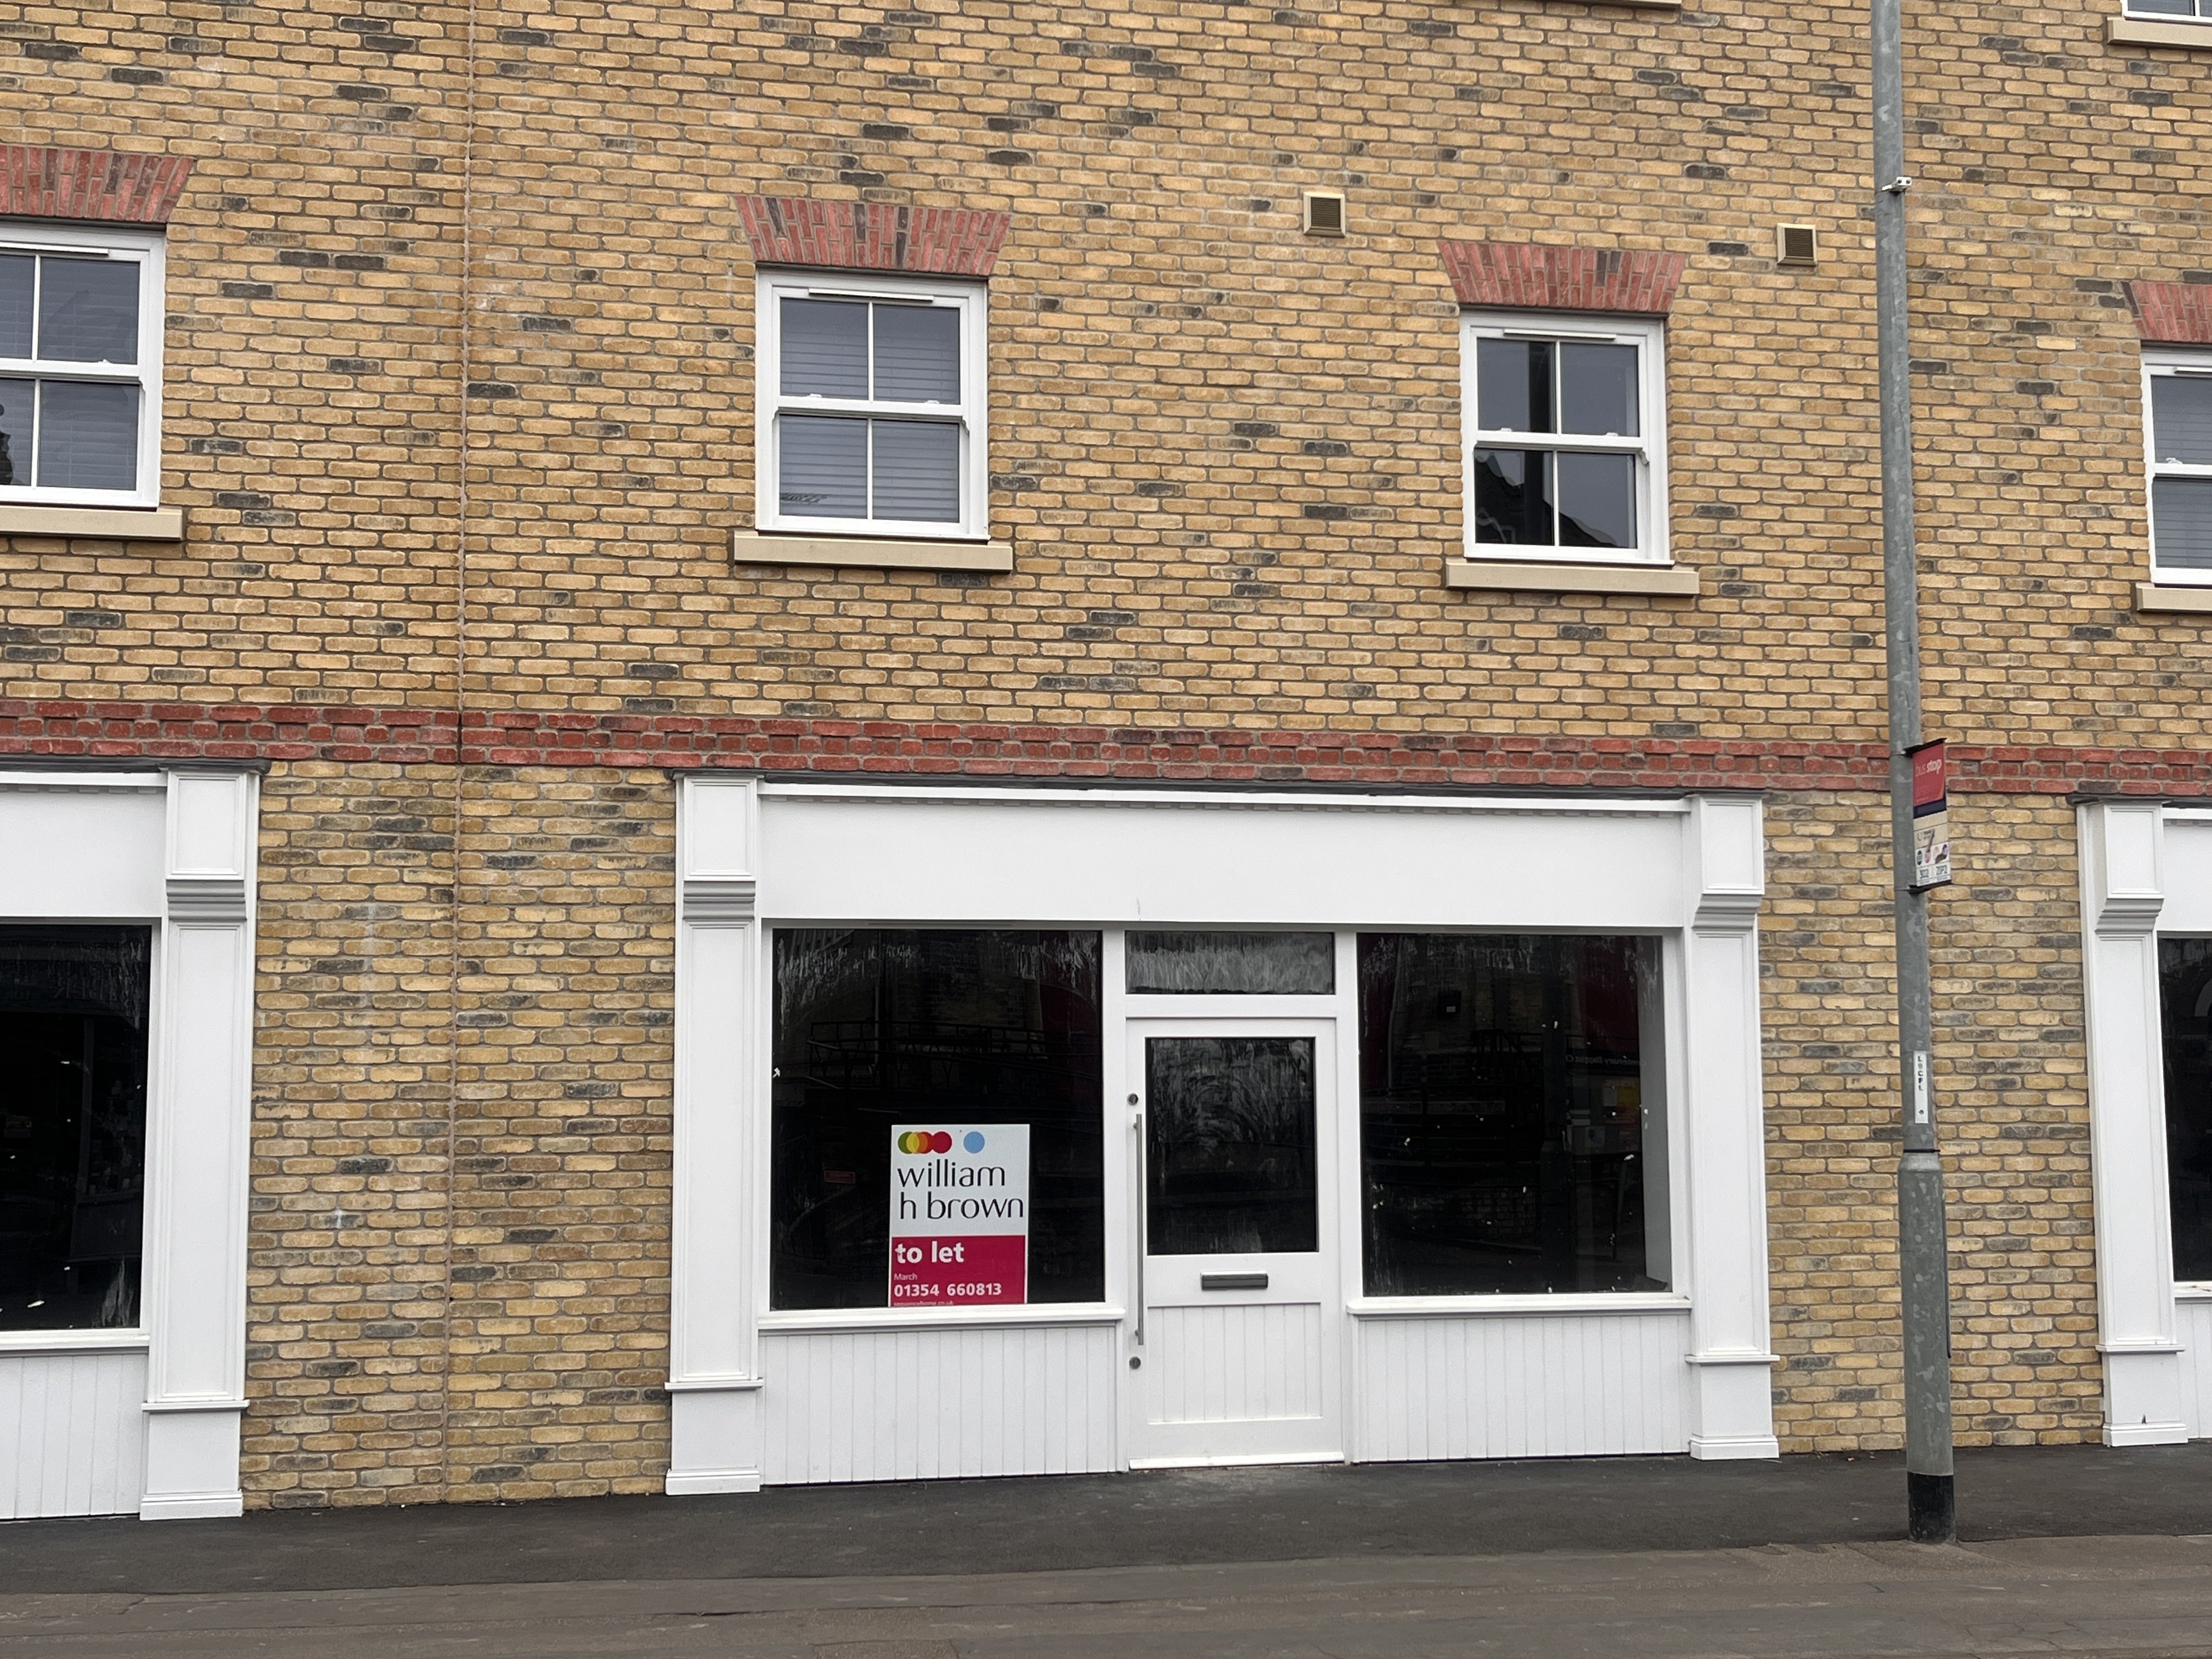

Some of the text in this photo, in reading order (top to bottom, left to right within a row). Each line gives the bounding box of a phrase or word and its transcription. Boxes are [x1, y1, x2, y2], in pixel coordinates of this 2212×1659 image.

[897, 1159, 1006, 1187] william
[900, 1191, 1024, 1220] h brown
[894, 1240, 964, 1263] to let
[894, 1272, 917, 1280] March
[894, 1283, 1002, 1297] 01354 660813
